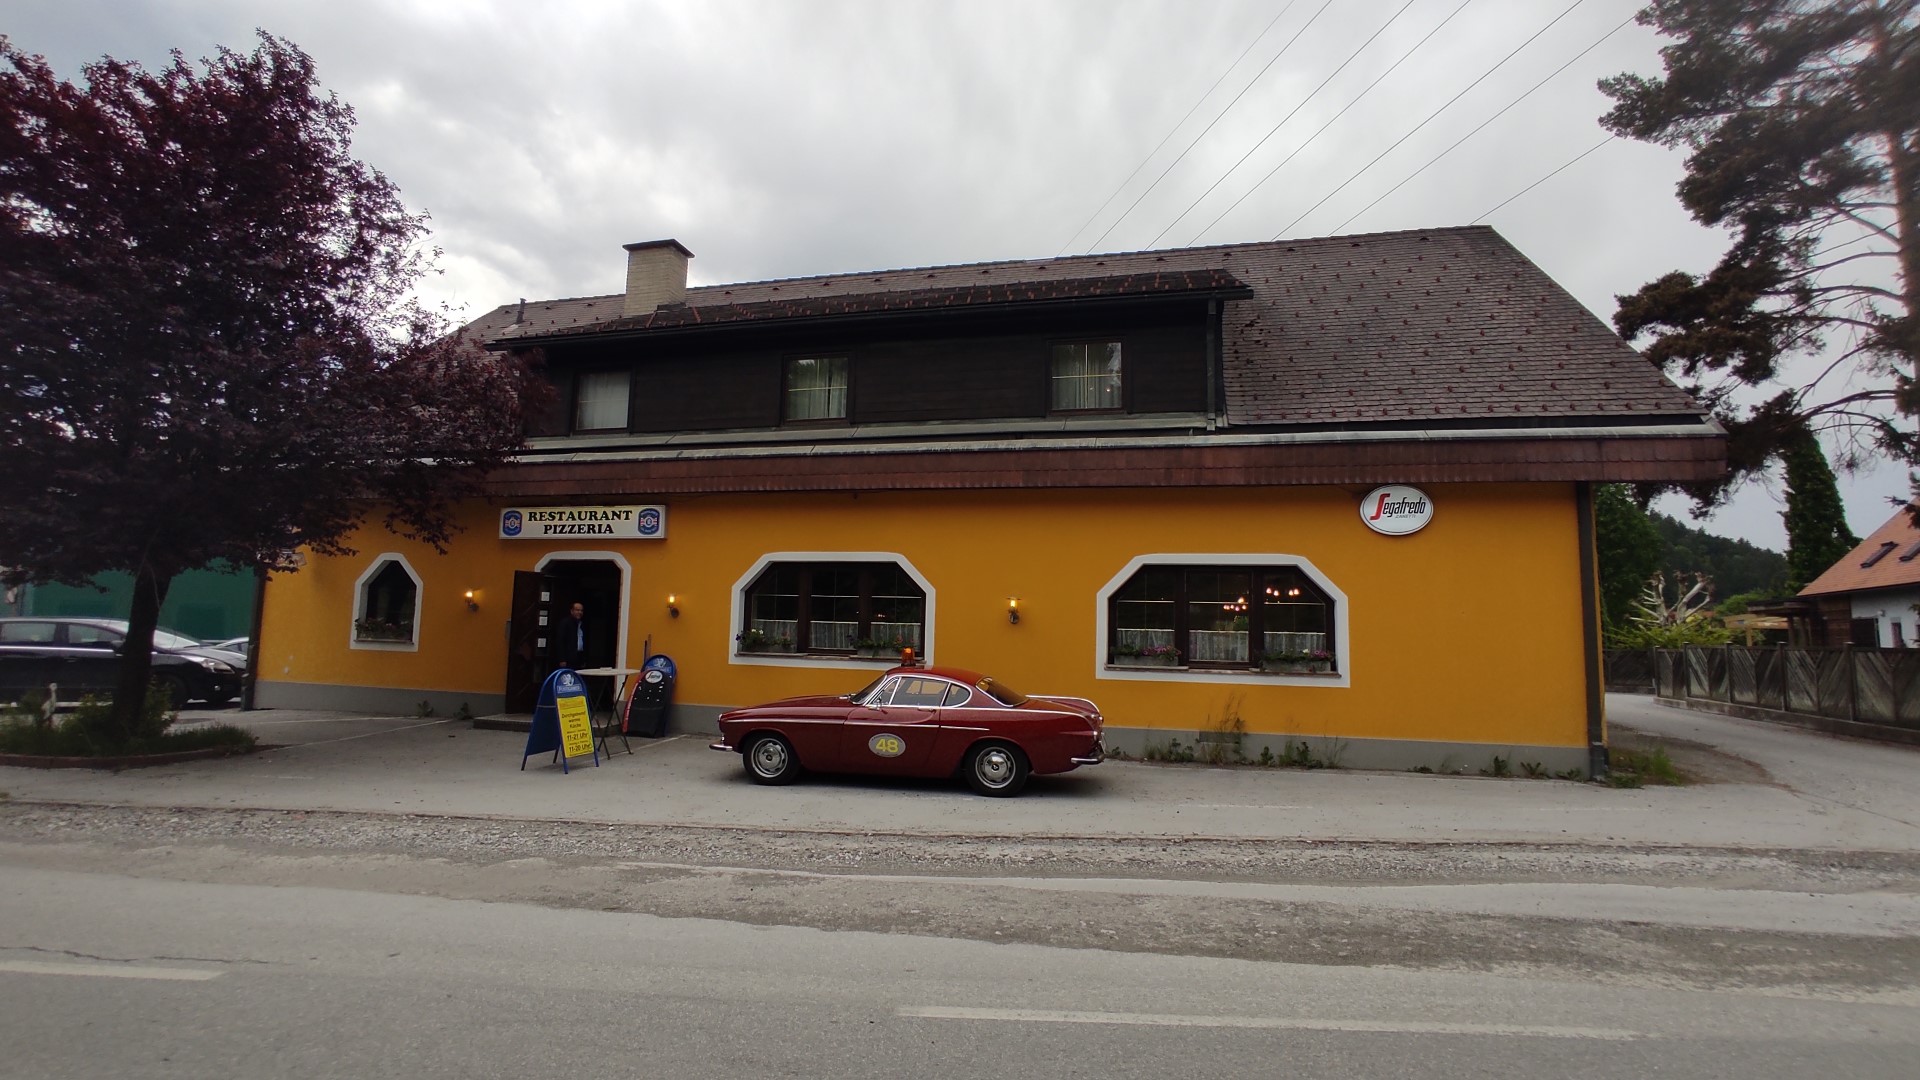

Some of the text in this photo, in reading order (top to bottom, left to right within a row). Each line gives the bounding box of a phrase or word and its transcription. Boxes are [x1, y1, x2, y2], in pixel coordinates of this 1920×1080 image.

[1369, 493, 1426, 521] Segafredo
[528, 510, 633, 522] RESTAURANT
[543, 524, 614, 535] PIZZERIA
[876, 738, 899, 753] 48
